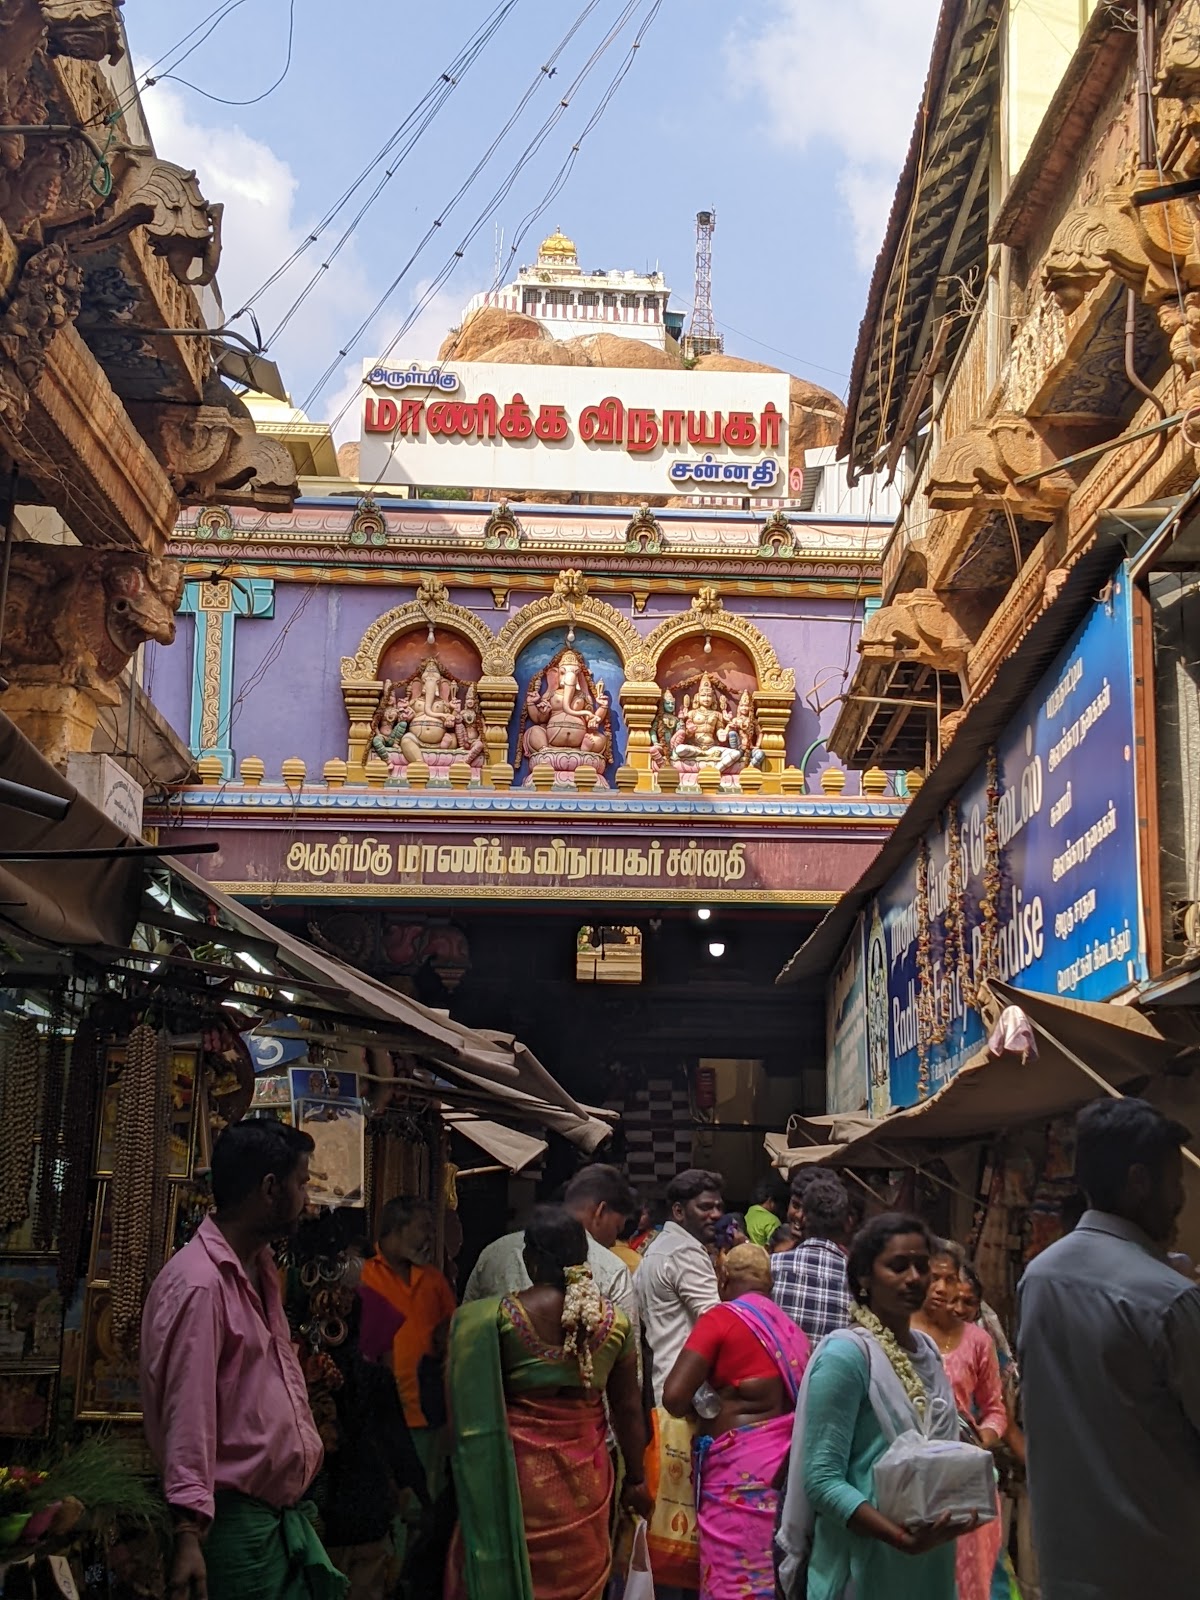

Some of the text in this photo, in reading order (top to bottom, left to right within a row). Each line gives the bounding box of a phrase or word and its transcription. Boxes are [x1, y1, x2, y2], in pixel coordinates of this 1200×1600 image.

[369, 364, 457, 391] அருள்மிகு
[364, 393, 782, 452] மாணிக்க விநாயகர்
[672, 455, 777, 488] சன்னதி
[286, 836, 746, 882] அருள்மிகு மாணிக்க விநாயகர் சன்னதி
